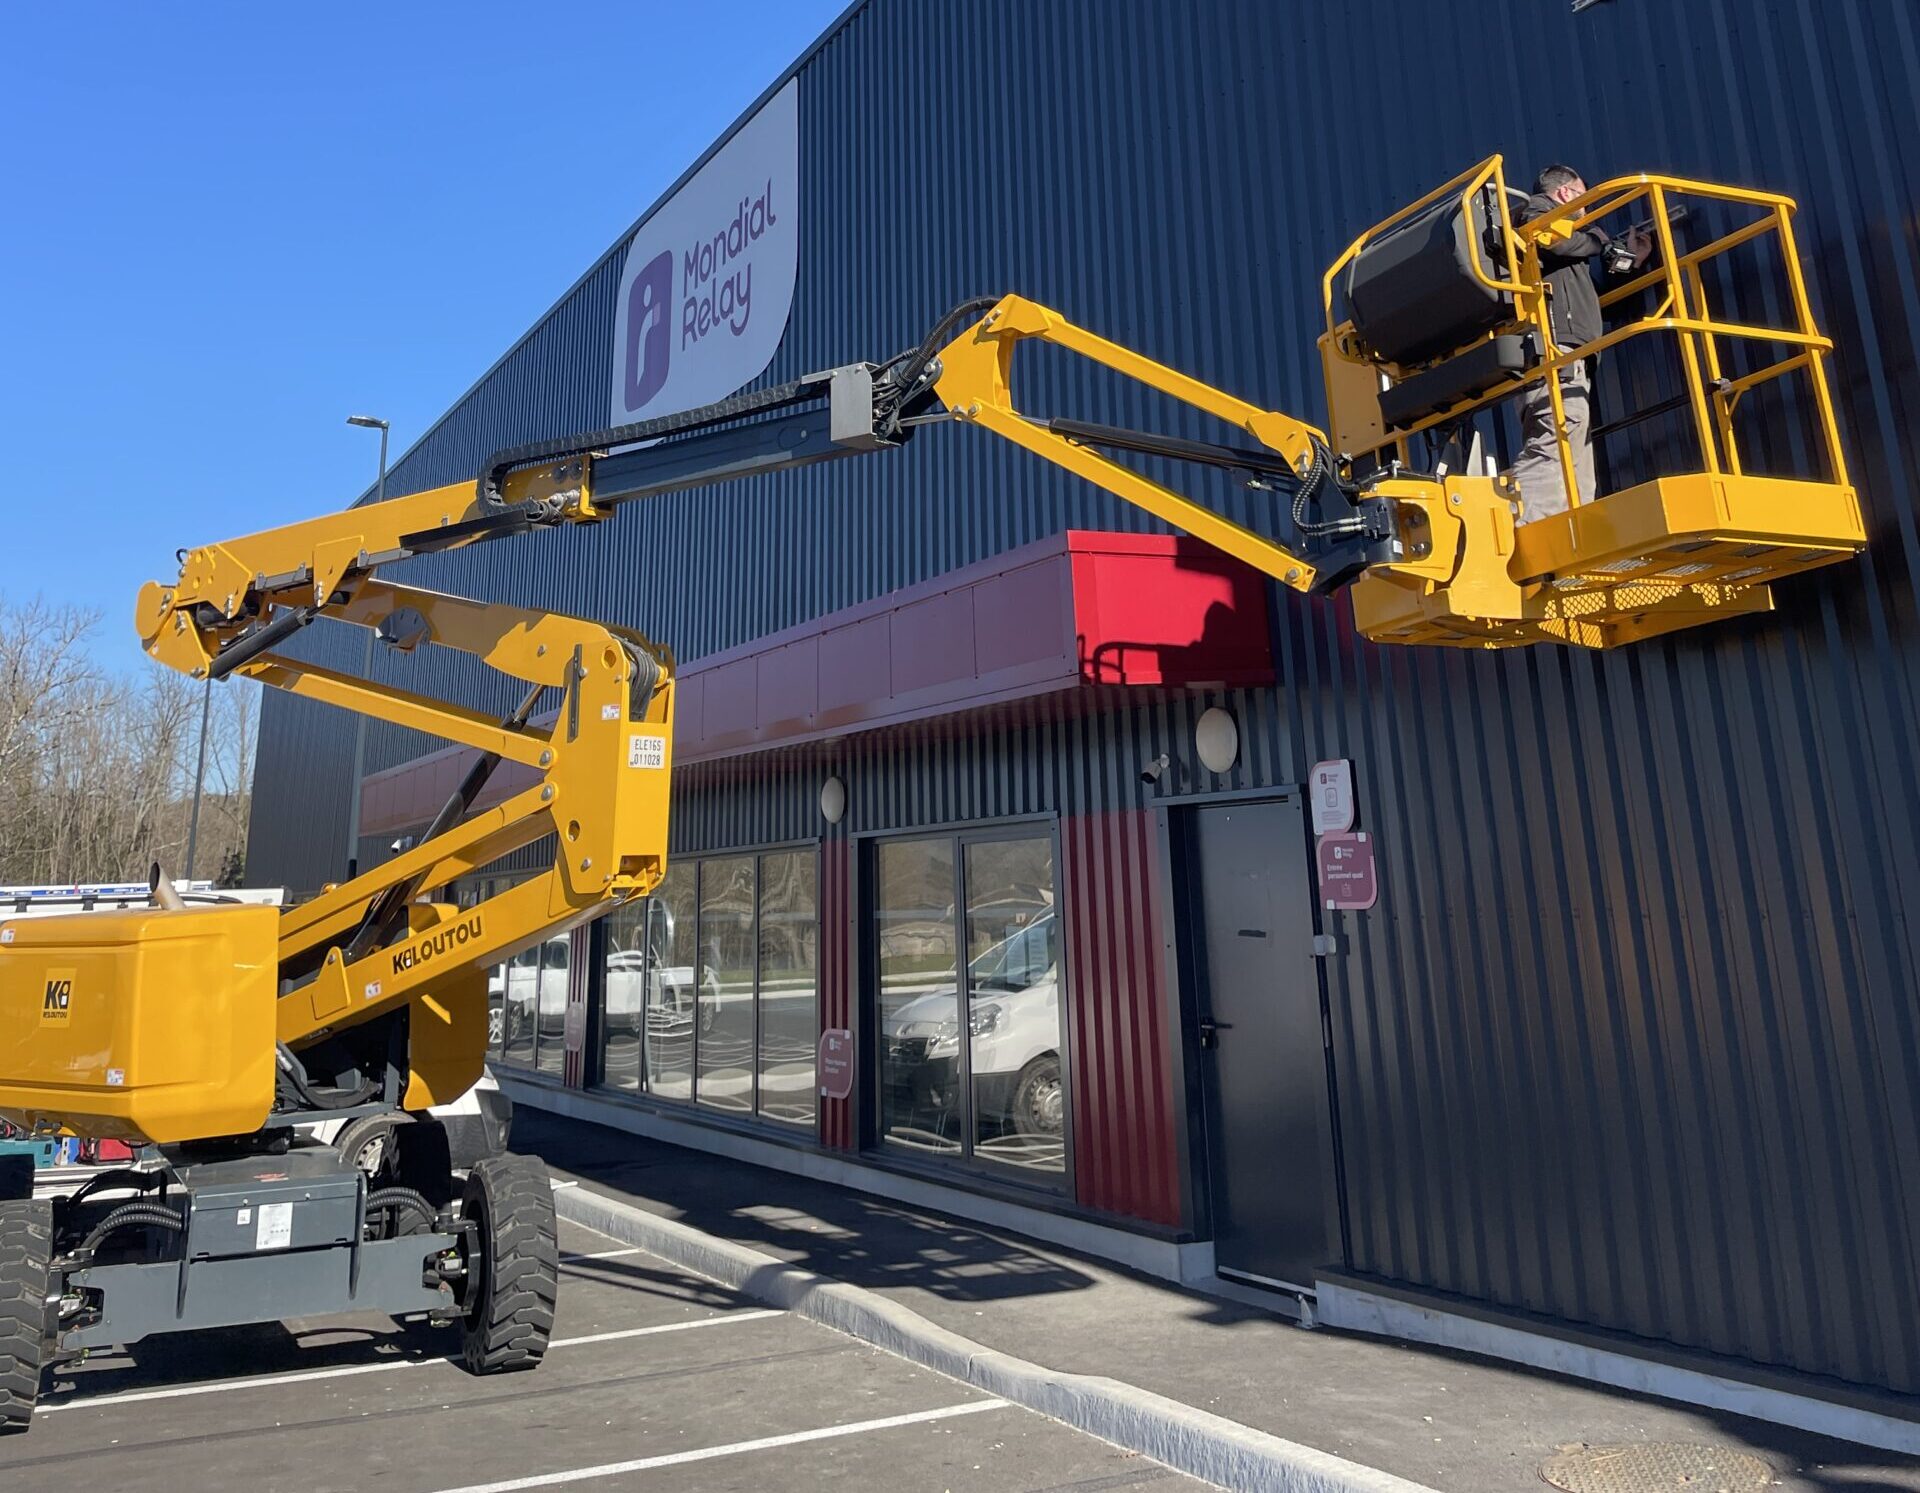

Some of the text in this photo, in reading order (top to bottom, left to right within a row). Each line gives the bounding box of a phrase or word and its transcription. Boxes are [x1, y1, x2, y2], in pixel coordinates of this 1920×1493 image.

[684, 177, 776, 298] Mondial
[682, 262, 751, 352] Relay
[634, 738, 662, 752] ELE16S
